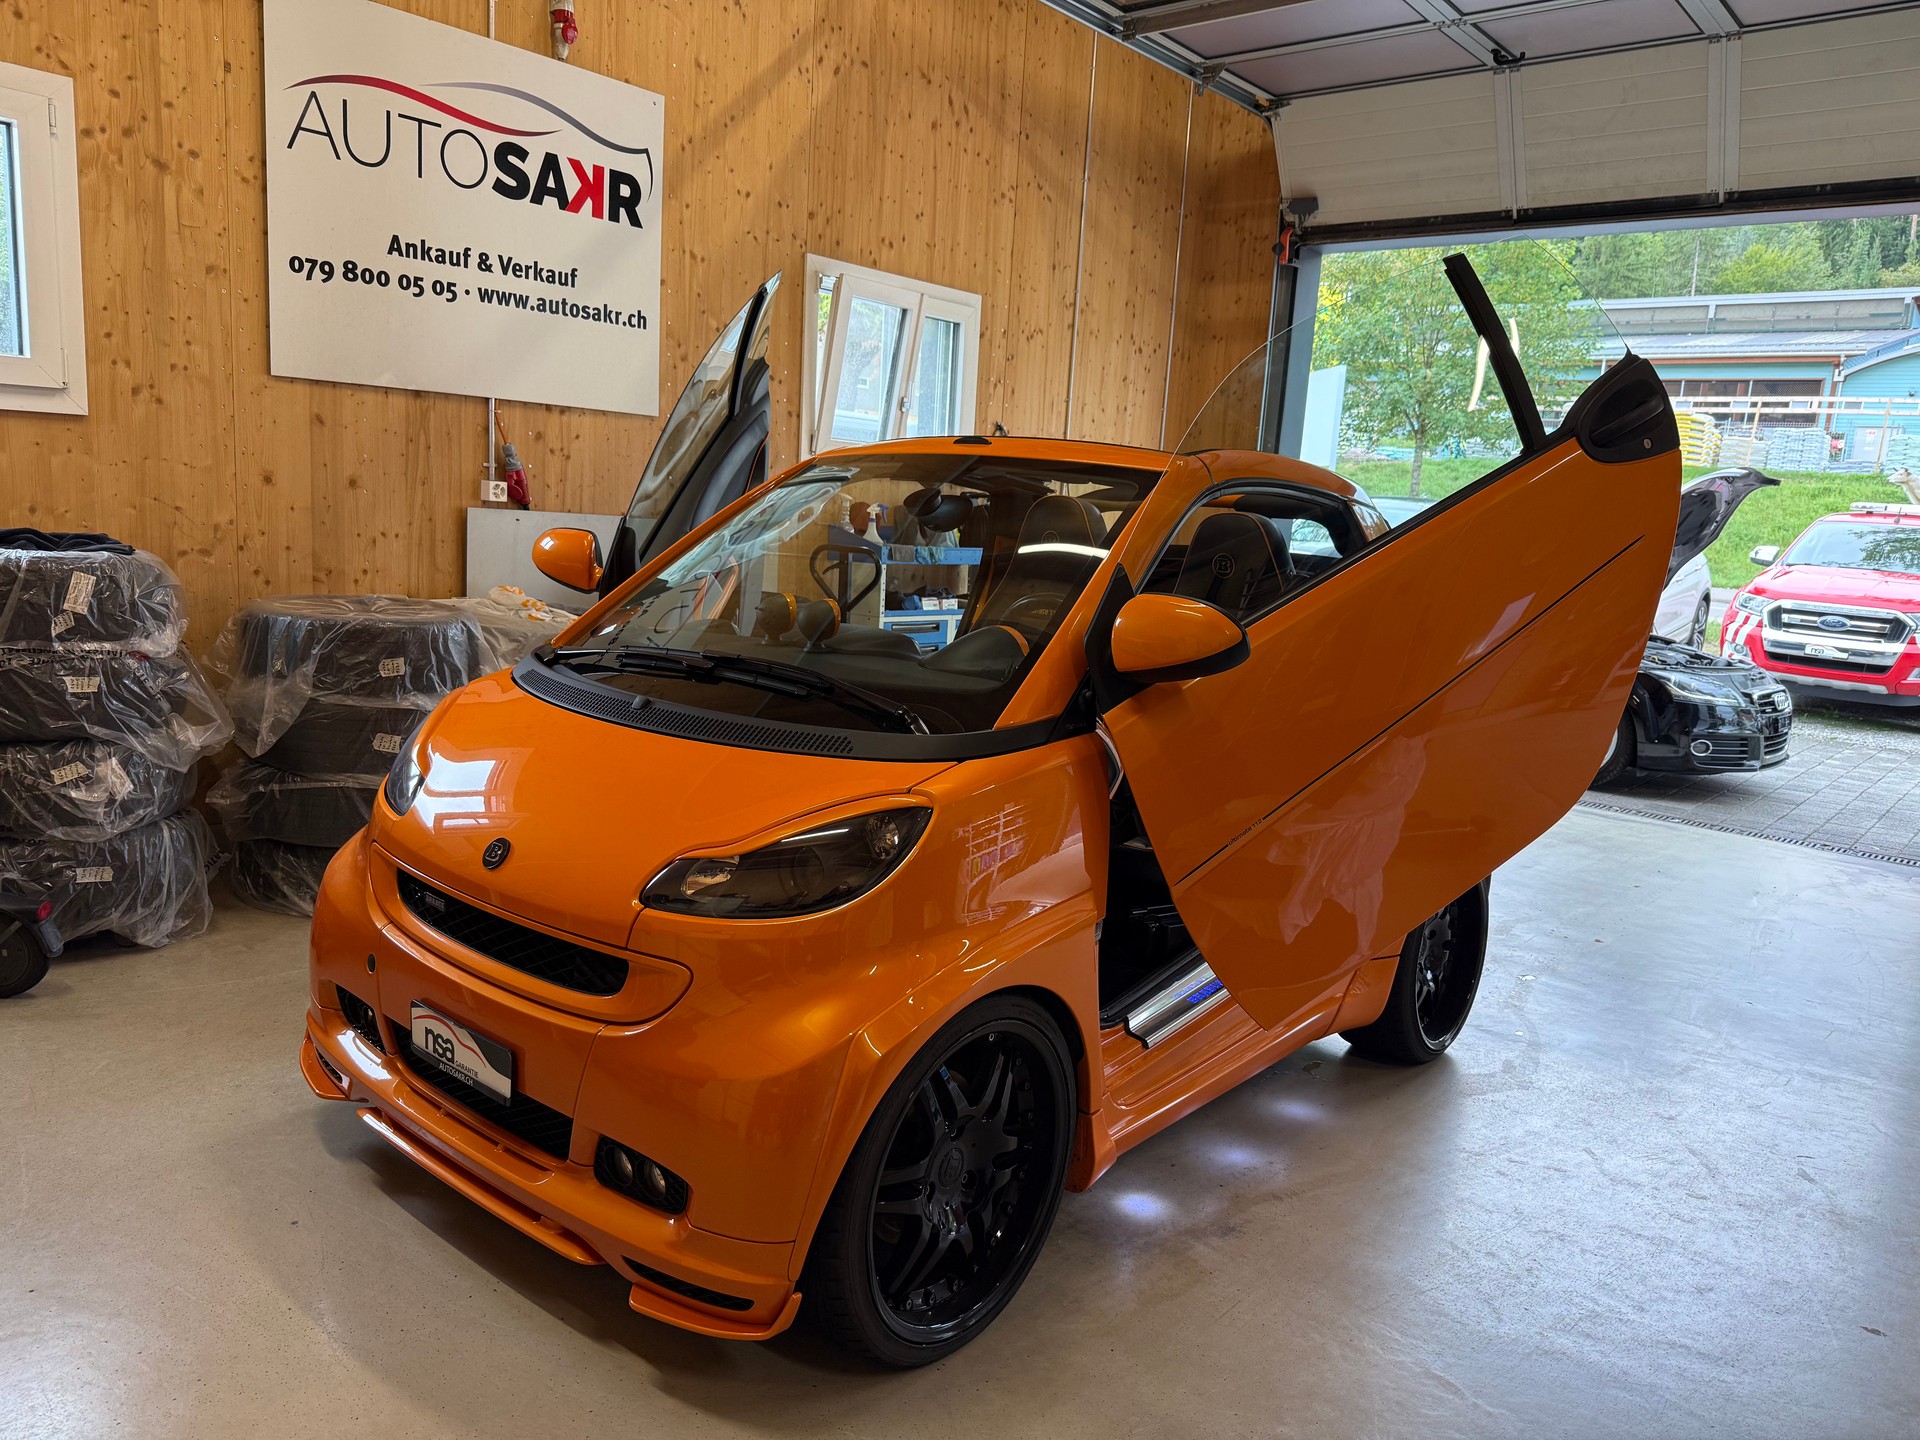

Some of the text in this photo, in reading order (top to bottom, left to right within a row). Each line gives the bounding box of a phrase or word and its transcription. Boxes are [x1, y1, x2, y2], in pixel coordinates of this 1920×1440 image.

[387, 234, 578, 289] Ankauf & Verkauf
[288, 254, 335, 284] 079
[342, 260, 390, 287] 800
[398, 274, 425, 298] 05
[431, 280, 458, 302] 05
[477, 286, 648, 330] www.autosakr.ch
[1228, 819, 1262, 846] ultimate 112
[425, 1026, 455, 1063] nsa
[455, 1060, 479, 1078] GARANTIE
